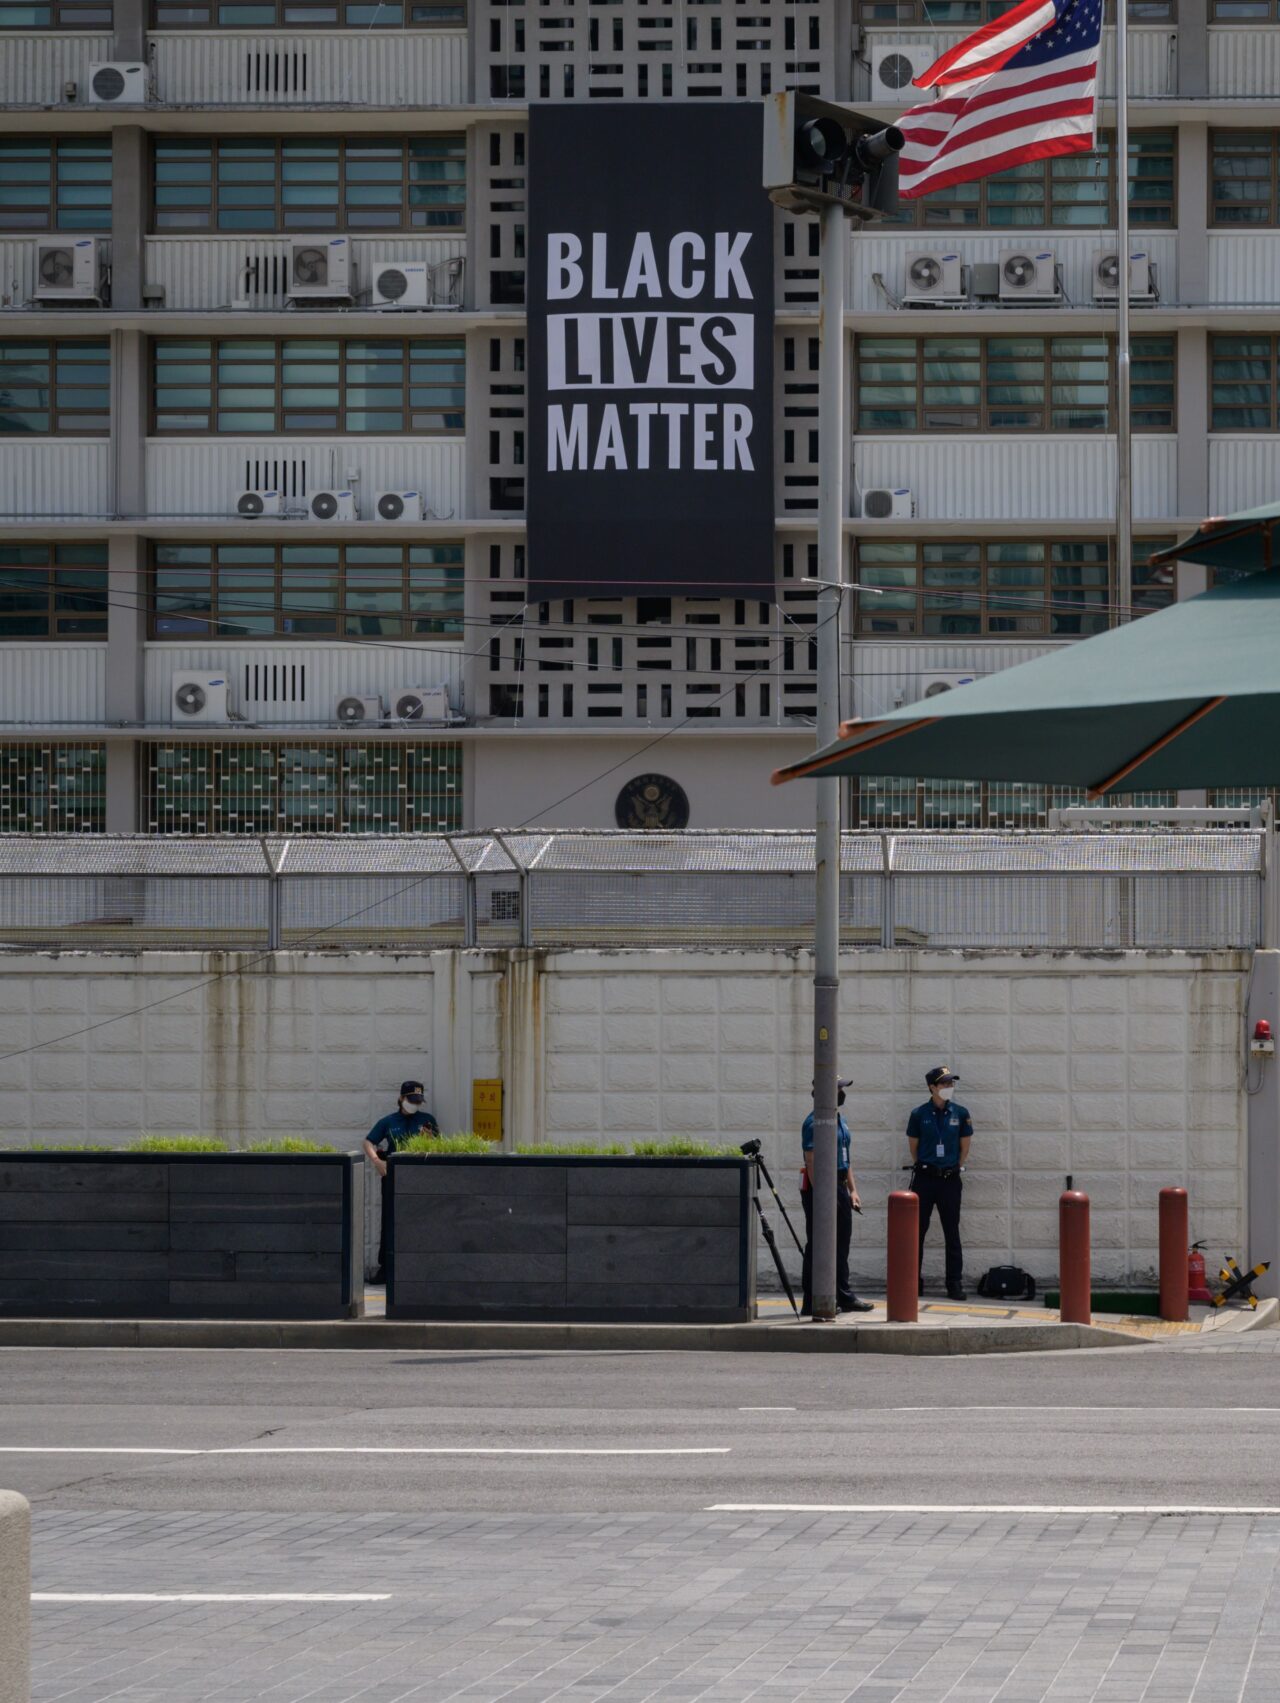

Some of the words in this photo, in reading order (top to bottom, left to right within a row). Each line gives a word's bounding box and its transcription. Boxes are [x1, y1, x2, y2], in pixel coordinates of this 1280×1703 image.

[546, 231, 754, 301] BLACK
[563, 315, 737, 386] LIVES
[546, 403, 755, 472] MATTER
